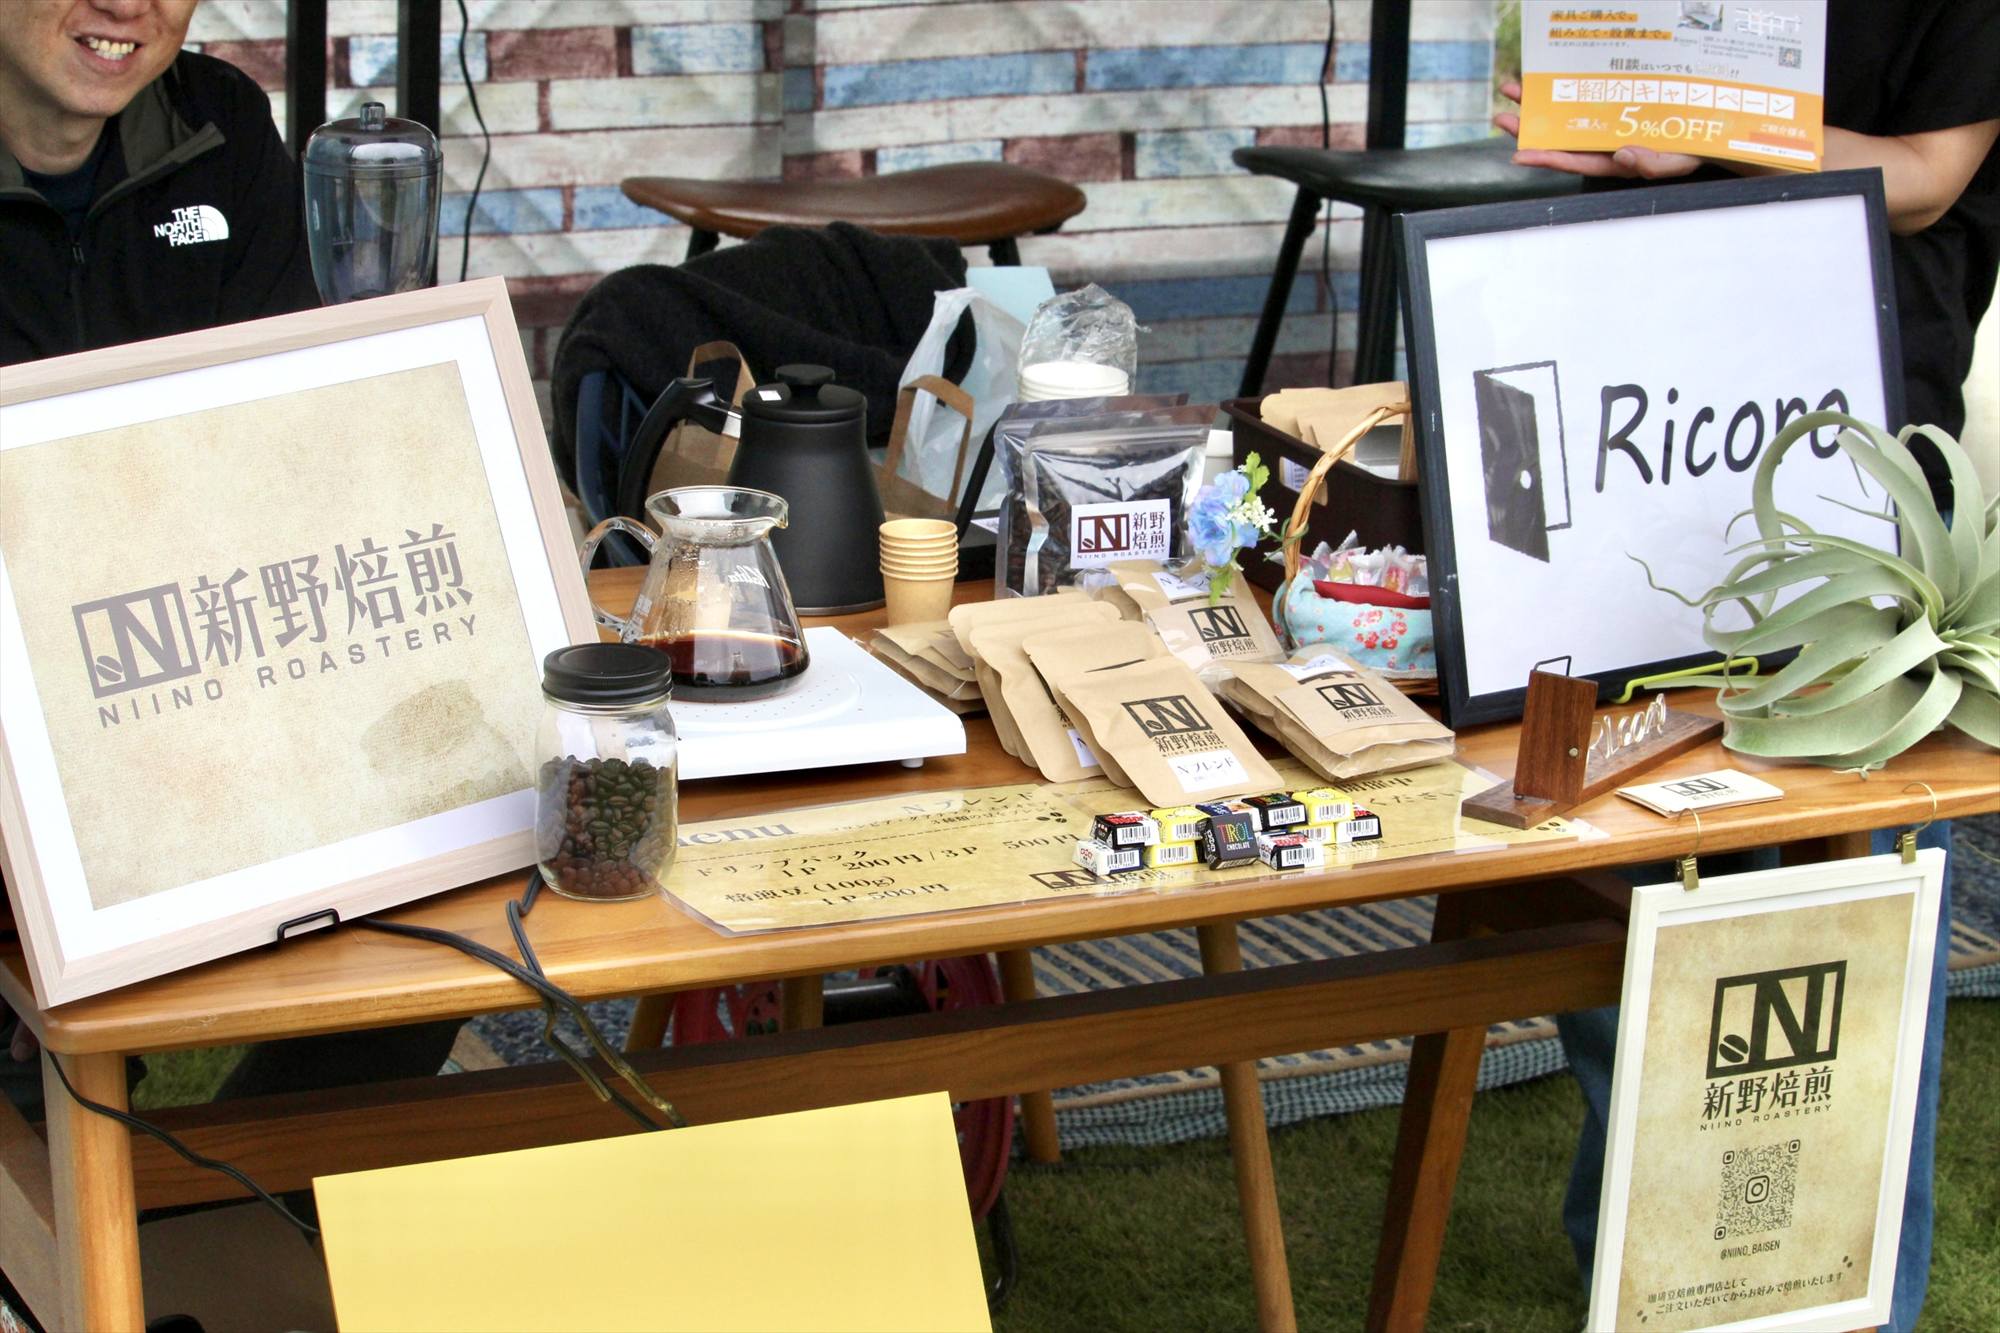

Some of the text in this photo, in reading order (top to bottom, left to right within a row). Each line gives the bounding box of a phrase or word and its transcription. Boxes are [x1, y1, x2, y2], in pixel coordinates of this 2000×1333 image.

[1556, 80, 1793, 115] ご紹介キャンペーン
[1616, 106, 1723, 142] 5%OFF
[171, 206, 200, 222] THE
[153, 219, 202, 237] NORTH
[169, 230, 204, 247] FACE
[1595, 384, 1849, 493] Ricoro
[1132, 511, 1165, 530] 新野
[1132, 530, 1165, 550] 焙煎
[191, 523, 474, 667] 新野焙煎
[1206, 638, 1258, 656] 新野焙煎
[98, 614, 477, 728] NIINO ROASTERY
[1154, 731, 1224, 752] 新野焙煎
[1217, 822, 1253, 843] TIROL
[813, 876, 896, 894] (100g)
[1701, 1065, 1834, 1121] 新野焙煎
[1699, 1104, 1833, 1132] NIINO ROASTERY
[1719, 1239, 1781, 1261] @NIINO_BAISEN
[1655, 1271, 1845, 1315] ご注文いただいてからお好みで焙煎いたします
